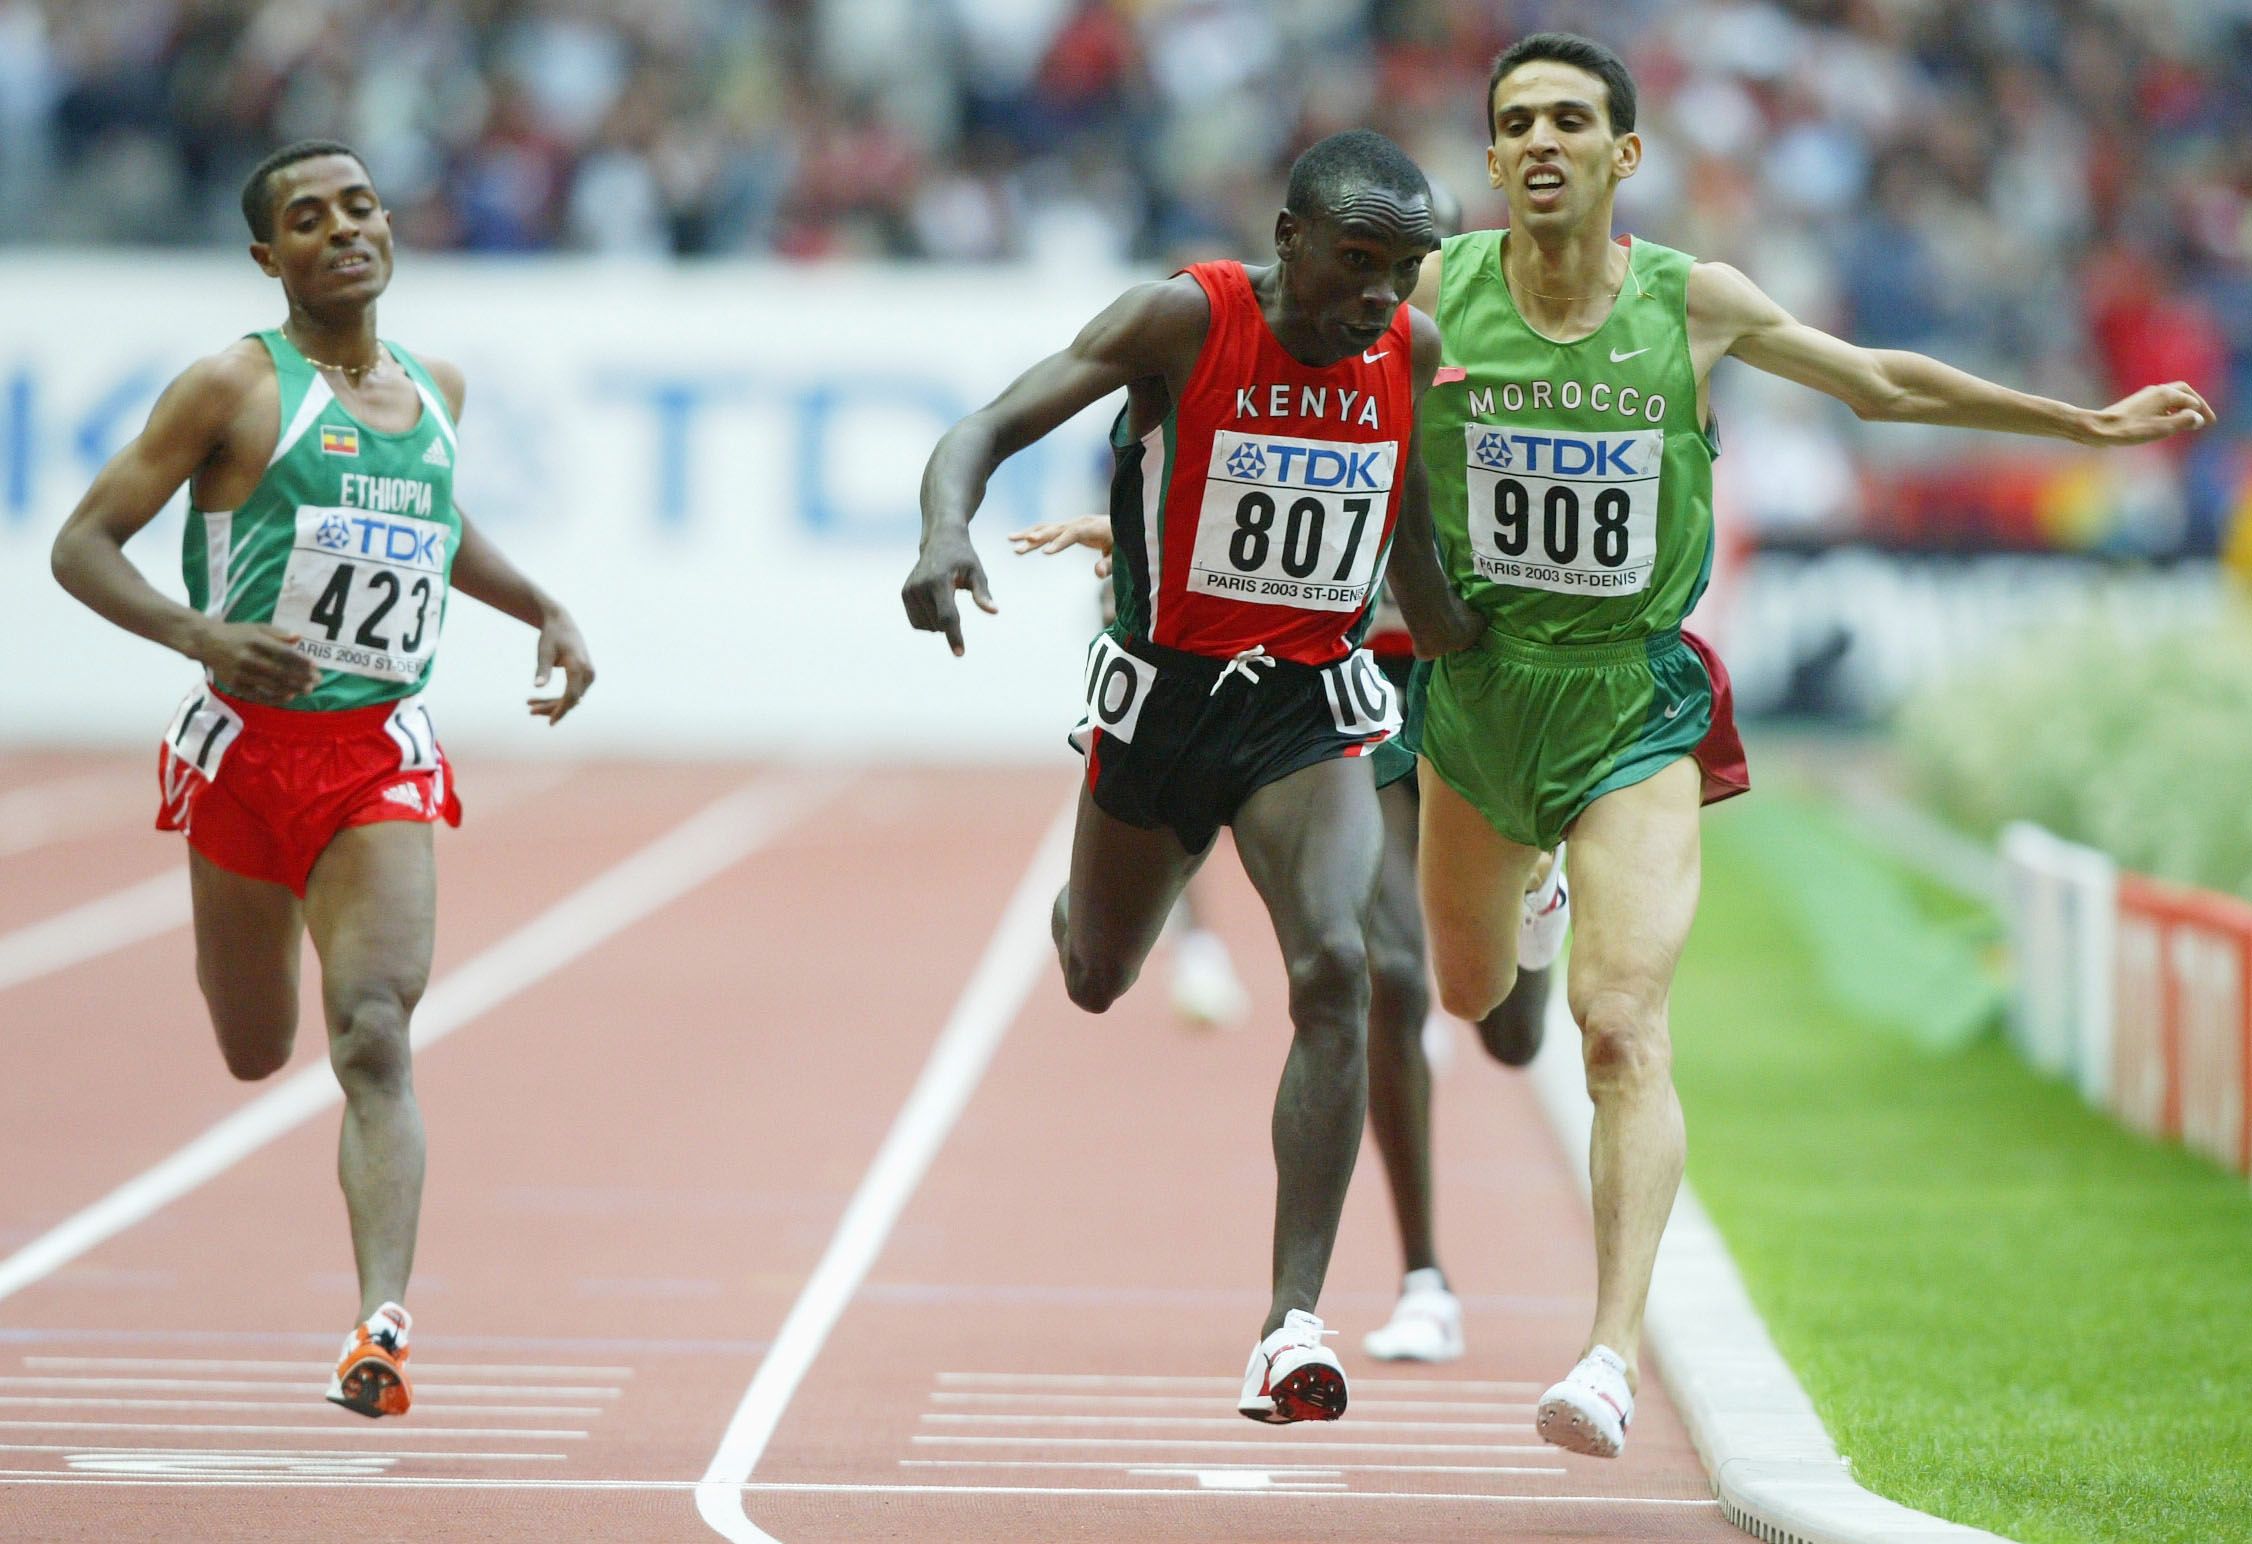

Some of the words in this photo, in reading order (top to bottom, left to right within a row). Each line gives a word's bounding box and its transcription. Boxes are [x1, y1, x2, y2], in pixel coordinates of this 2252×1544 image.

[1236, 384, 1379, 431] KENYA
[1467, 379, 1668, 423] MOROCCO
[1266, 444, 1380, 489] TDK
[1510, 434, 1639, 477] TDK
[340, 472, 434, 516] ETHIOPIA
[351, 517, 438, 566] TDK
[1227, 490, 1373, 582] 807
[1493, 478, 1631, 568] 908
[1207, 573, 1257, 594] PARIS
[1260, 581, 1299, 598] 2003
[1302, 586, 1364, 602] ST-DEN
[1525, 566, 1560, 582] 2003
[1564, 571, 1637, 587] ST-DENIS
[309, 563, 432, 655] 423
[296, 641, 332, 660] ARIS
[335, 649, 370, 666] 2003
[1086, 643, 1138, 726] 10
[1329, 655, 1387, 727] 10
[175, 696, 230, 769] 11
